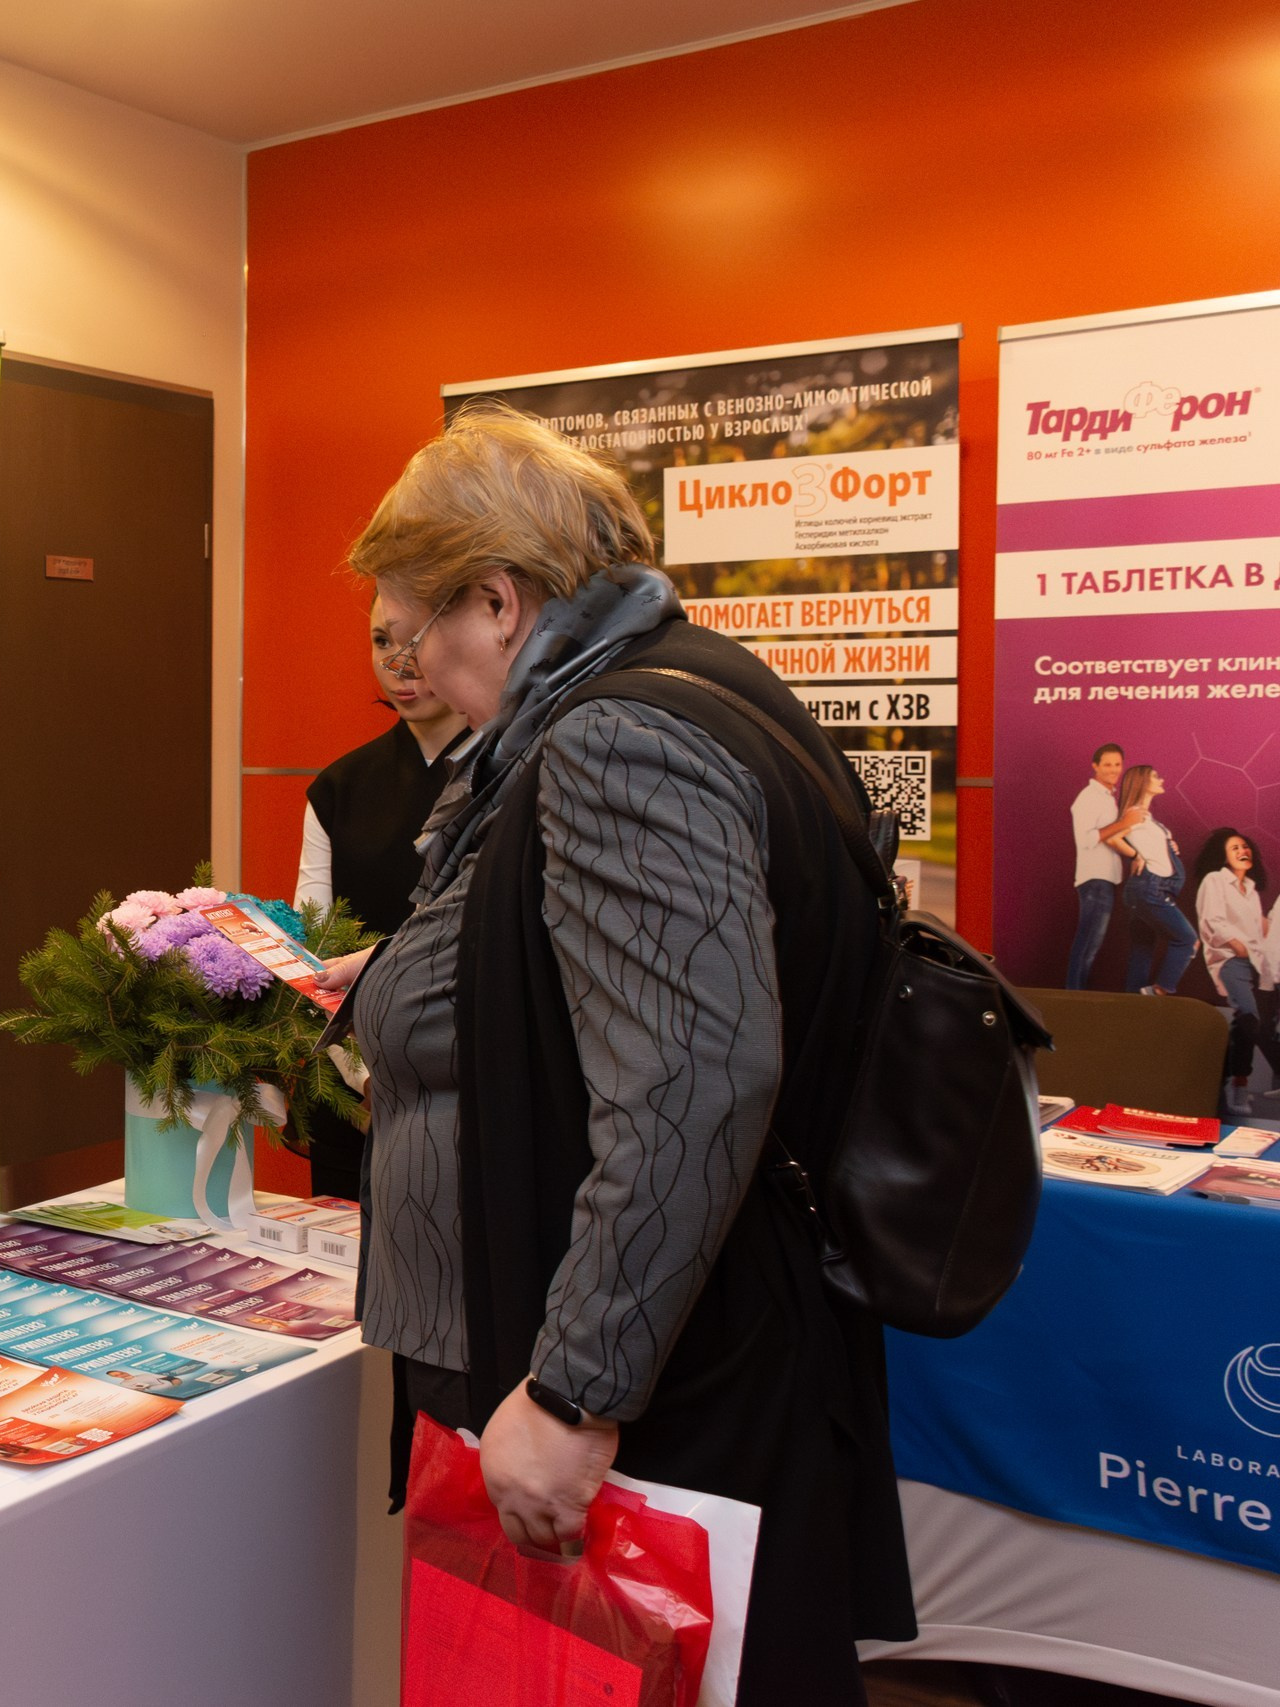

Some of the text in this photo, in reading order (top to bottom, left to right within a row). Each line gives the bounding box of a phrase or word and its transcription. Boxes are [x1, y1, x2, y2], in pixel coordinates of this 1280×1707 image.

[613, 403, 699, 427] СВЯЗАННЫХ
[704, 402, 712, 418] С
[717, 376, 932, 416] ВЕНОЗНО-ЛИМФАТИЧЕСКОЙ
[710, 421, 720, 438] У
[1027, 451, 1042, 461] 80
[1045, 450, 1058, 459] мг
[1136, 438, 1195, 453] сульфата
[849, 538, 879, 549] кислота
[1036, 562, 1265, 596] 1 ТАБЛЕТКА В
[801, 596, 930, 628] ВЕРНУТЬСЯ
[843, 644, 930, 674] ЖИЗНИ
[1034, 655, 1212, 680] Соответствует
[1034, 686, 1081, 704] для
[1088, 684, 1199, 701] лечения
[869, 700, 879, 721] с
[1099, 1452, 1272, 1532] Pierre
